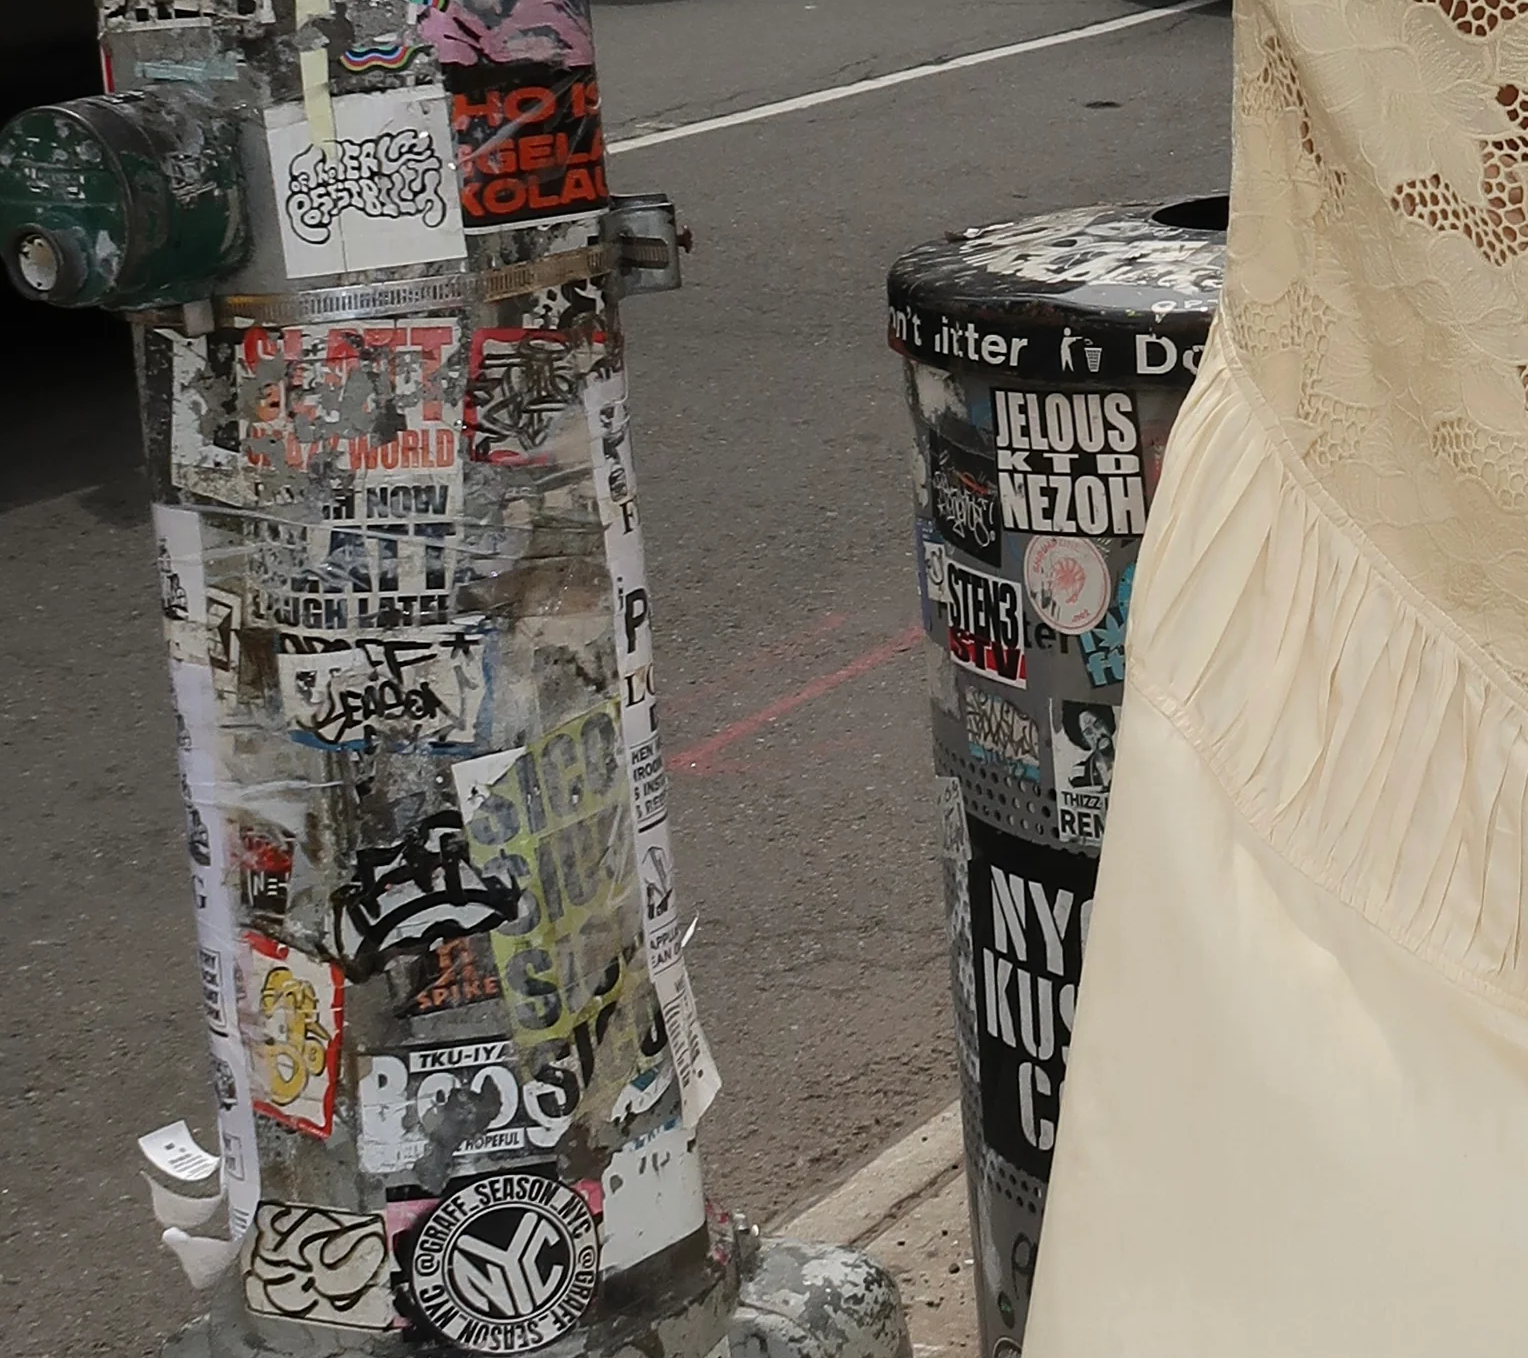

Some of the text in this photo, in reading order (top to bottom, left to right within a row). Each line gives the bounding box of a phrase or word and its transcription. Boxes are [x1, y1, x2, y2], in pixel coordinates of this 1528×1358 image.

[994, 390, 1138, 454] JELOUS
[997, 449, 1141, 475] K T D
[998, 471, 1147, 536] NEZOH
[990, 863, 1094, 977] NY
